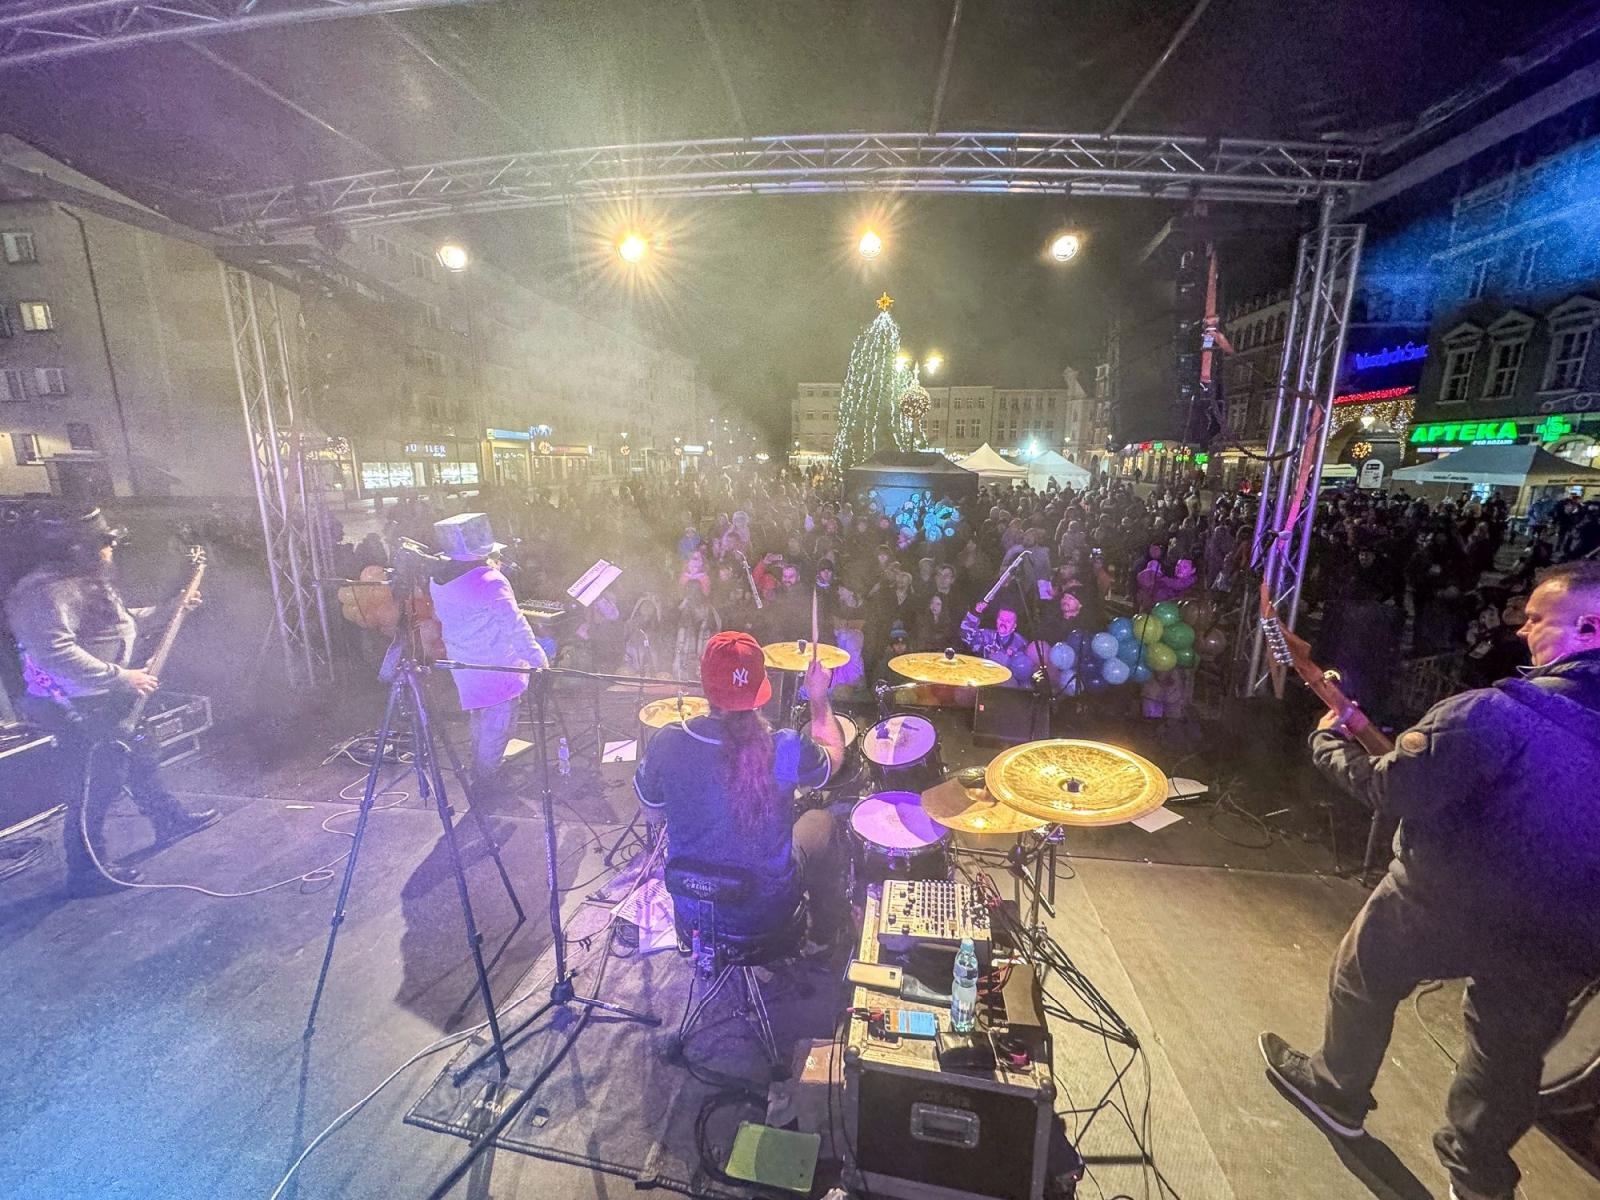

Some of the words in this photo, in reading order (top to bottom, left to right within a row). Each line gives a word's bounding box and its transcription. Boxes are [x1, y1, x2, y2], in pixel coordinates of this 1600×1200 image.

[1410, 421, 1518, 442] APTEKA
[404, 443, 447, 454] JUILER
[732, 667, 749, 687] NY
